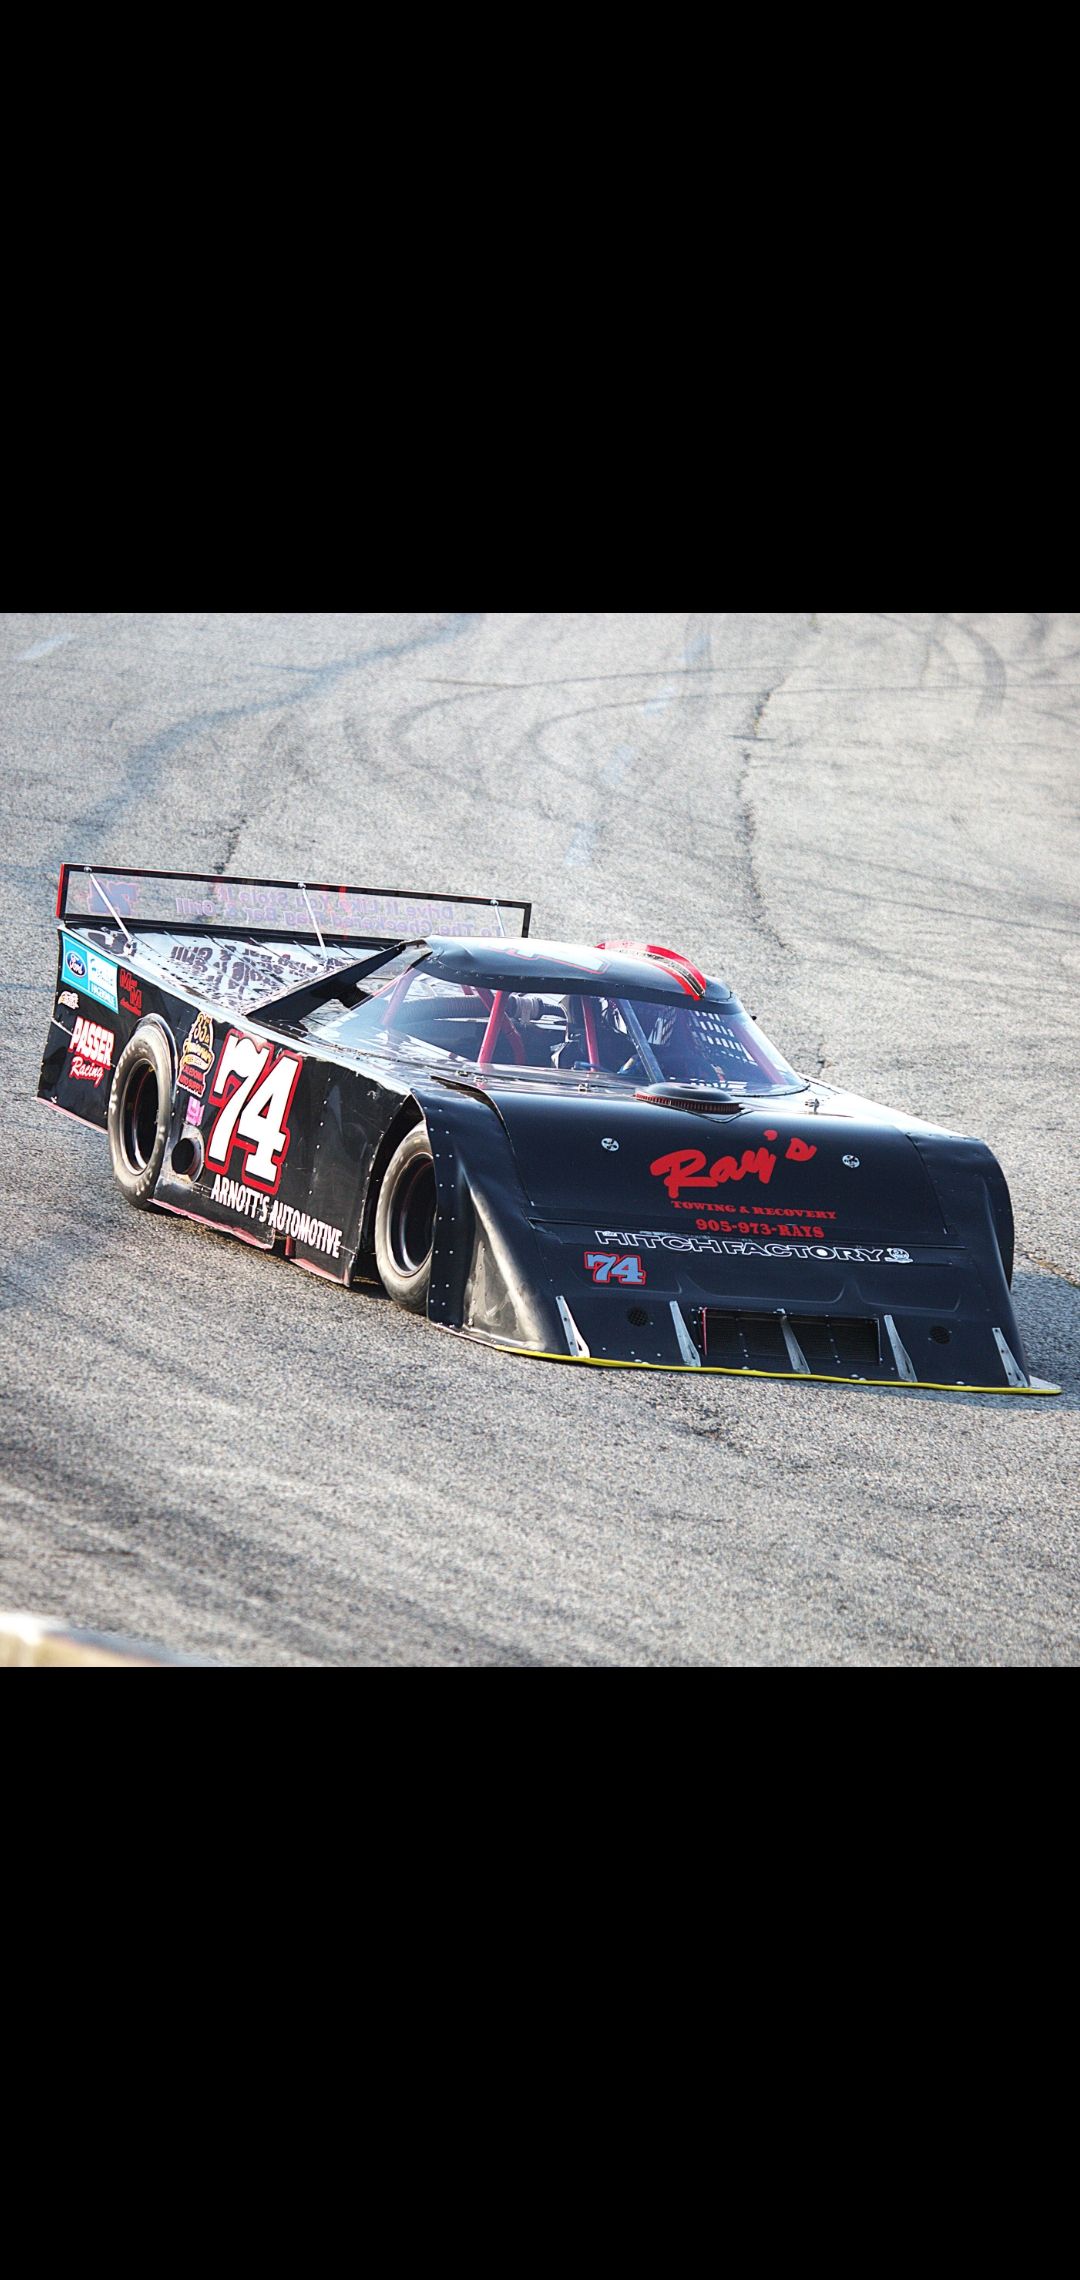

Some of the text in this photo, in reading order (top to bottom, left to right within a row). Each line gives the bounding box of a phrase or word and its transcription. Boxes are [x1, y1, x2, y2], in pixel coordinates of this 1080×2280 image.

[69, 1016, 115, 1069] PASSER
[69, 1056, 104, 1088] Racing
[205, 1030, 302, 1192] 74
[650, 1130, 817, 1198] Ray's
[210, 1174, 342, 1258] ARNOTT'S AUTOMOTIVE
[671, 1200, 837, 1220] TOWING & RECOVERY
[696, 1218, 825, 1239] 905-973-RAYS
[595, 1230, 723, 1254] HITCH
[722, 1240, 885, 1262] FACTORY
[584, 1251, 647, 1285] 74
